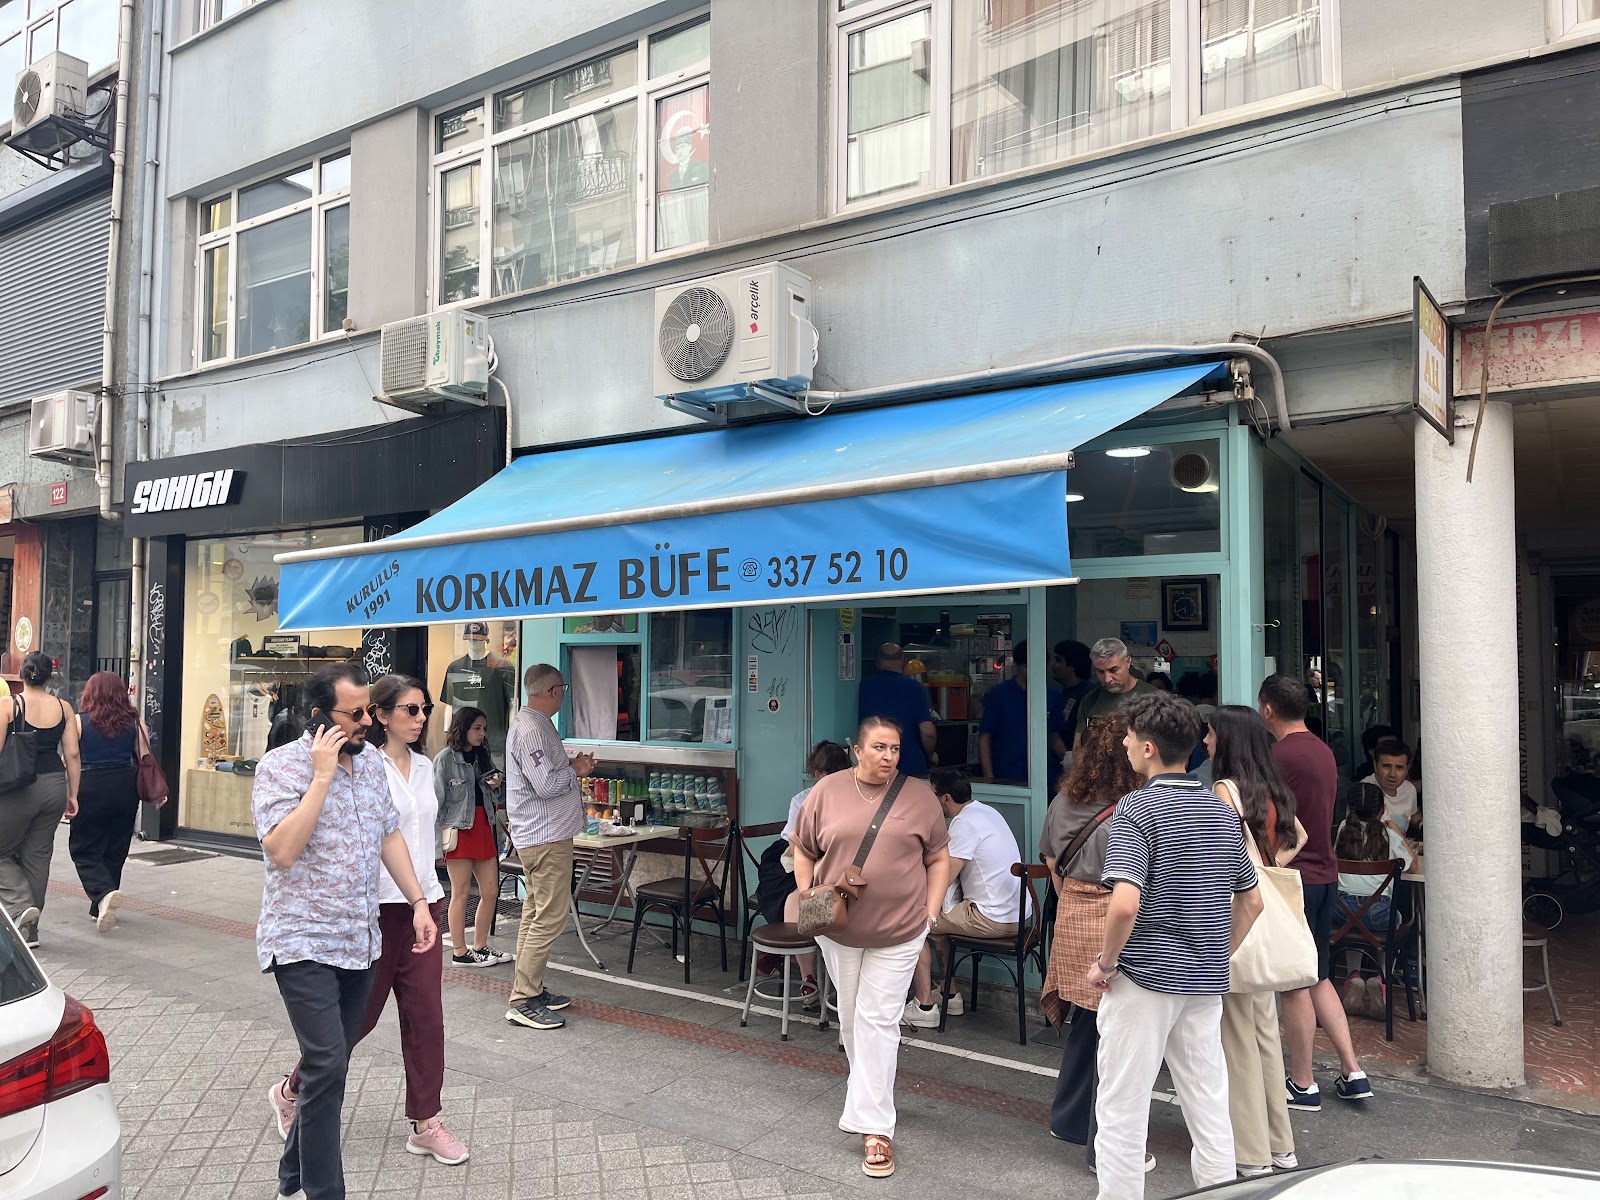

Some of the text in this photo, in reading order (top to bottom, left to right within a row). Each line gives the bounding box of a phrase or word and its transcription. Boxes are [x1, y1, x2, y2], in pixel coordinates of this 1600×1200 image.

[750, 280, 760, 320] arçelik
[53, 487, 64, 500] 122
[131, 469, 234, 514] SOHIGH
[346, 559, 400, 614] KURULUŞ
[416, 542, 908, 614] KORKMAZ BÜFE 337 52 10
[363, 588, 391, 620] 1991
[530, 750, 544, 767] P
